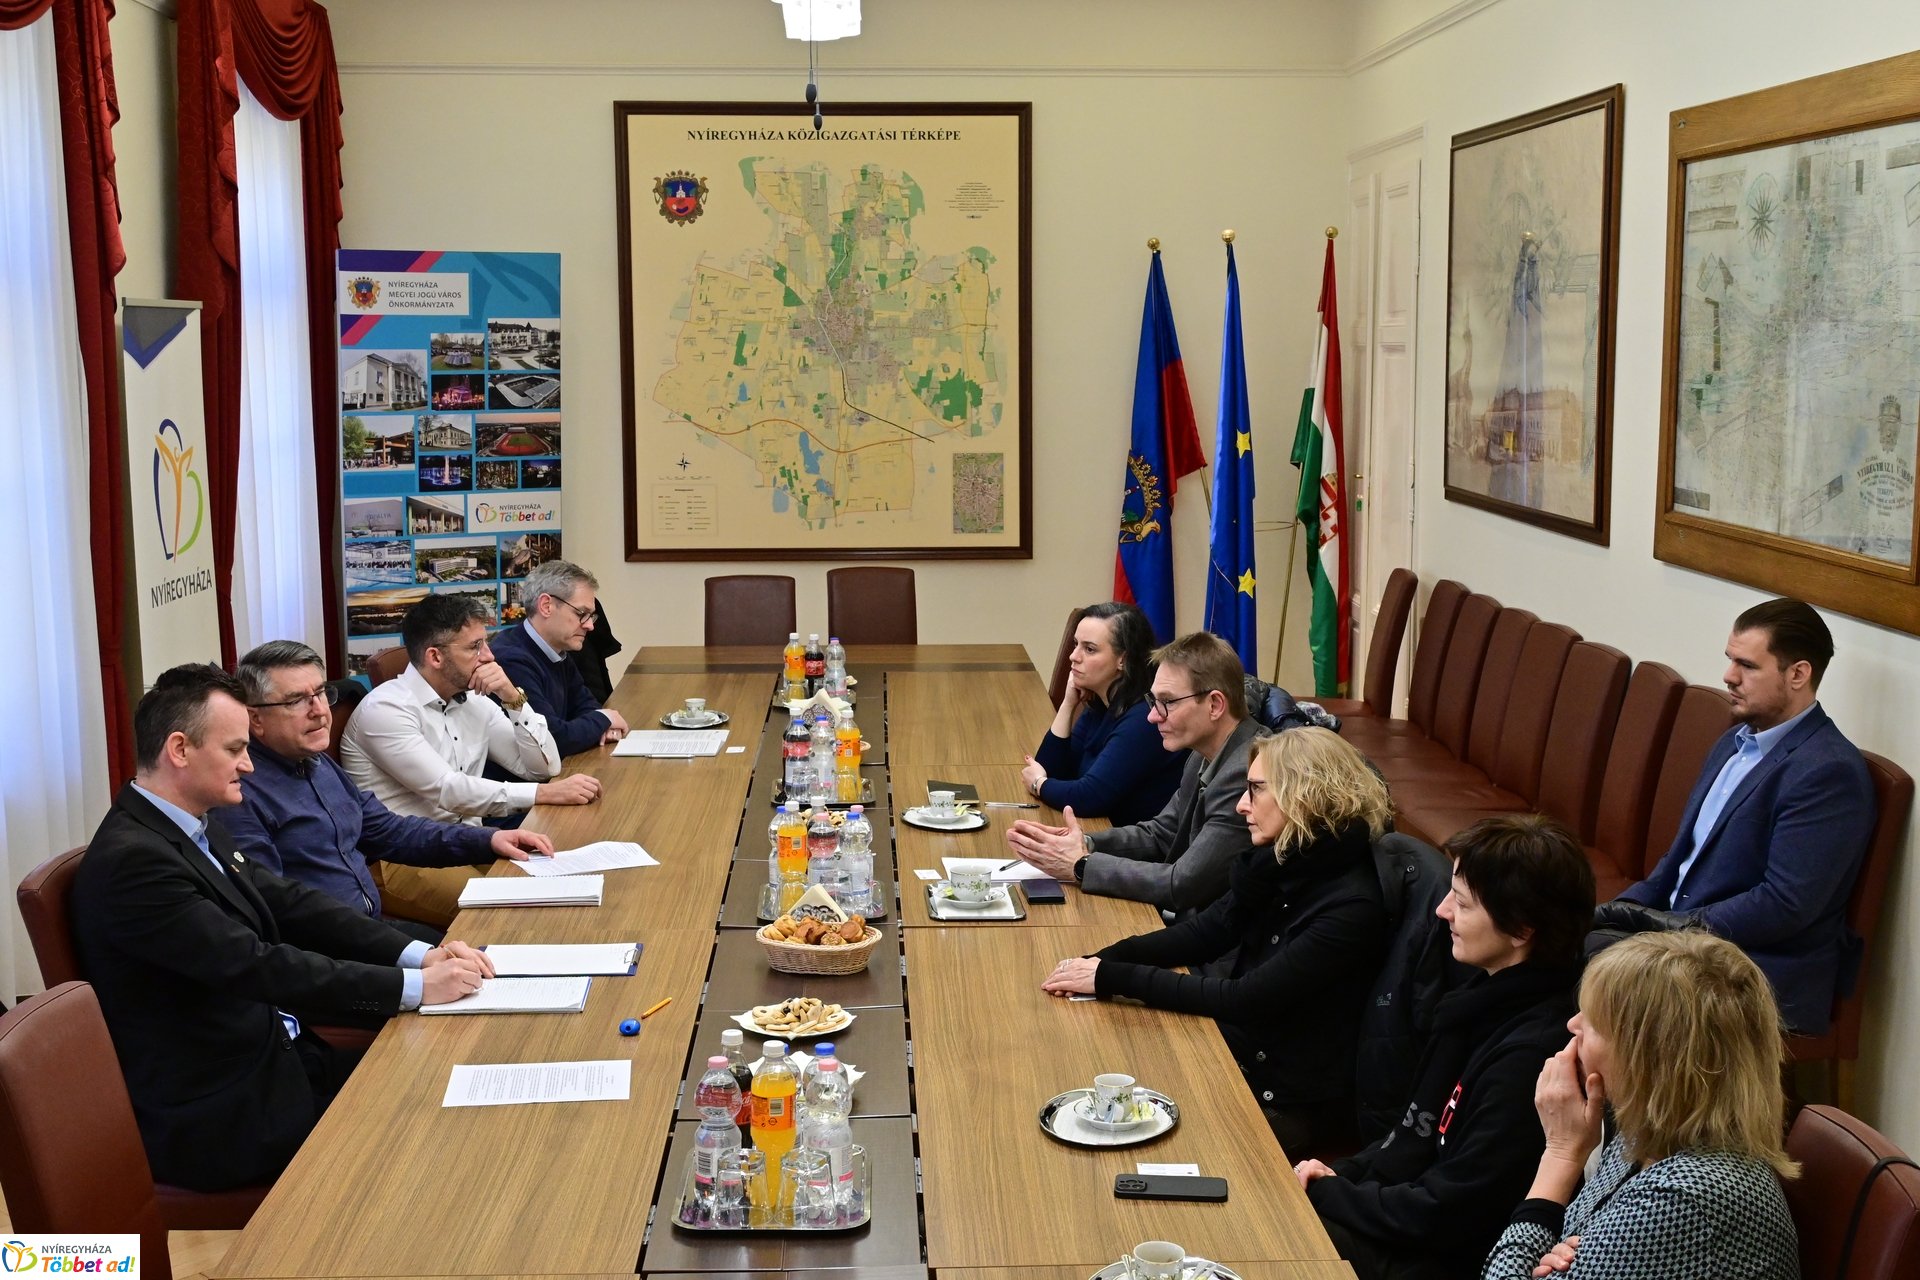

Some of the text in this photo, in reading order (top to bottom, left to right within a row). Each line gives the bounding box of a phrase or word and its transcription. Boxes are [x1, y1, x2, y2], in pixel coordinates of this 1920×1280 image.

[687, 128, 961, 141] NYÍREGYHÁZA KÖZIGAZGATÁSI TÉRKÉPE
[388, 279, 439, 289] NYÍREGYHÁZA
[388, 289, 462, 299] MEGYEI JOGÚ VÁROS
[388, 299, 455, 309] ÖNKORMÁNYZATA
[499, 503, 542, 512] NYÍREGYHÁZA
[499, 510, 555, 523] Többet ad!
[151, 566, 213, 609] NYÍREGYHÁZA
